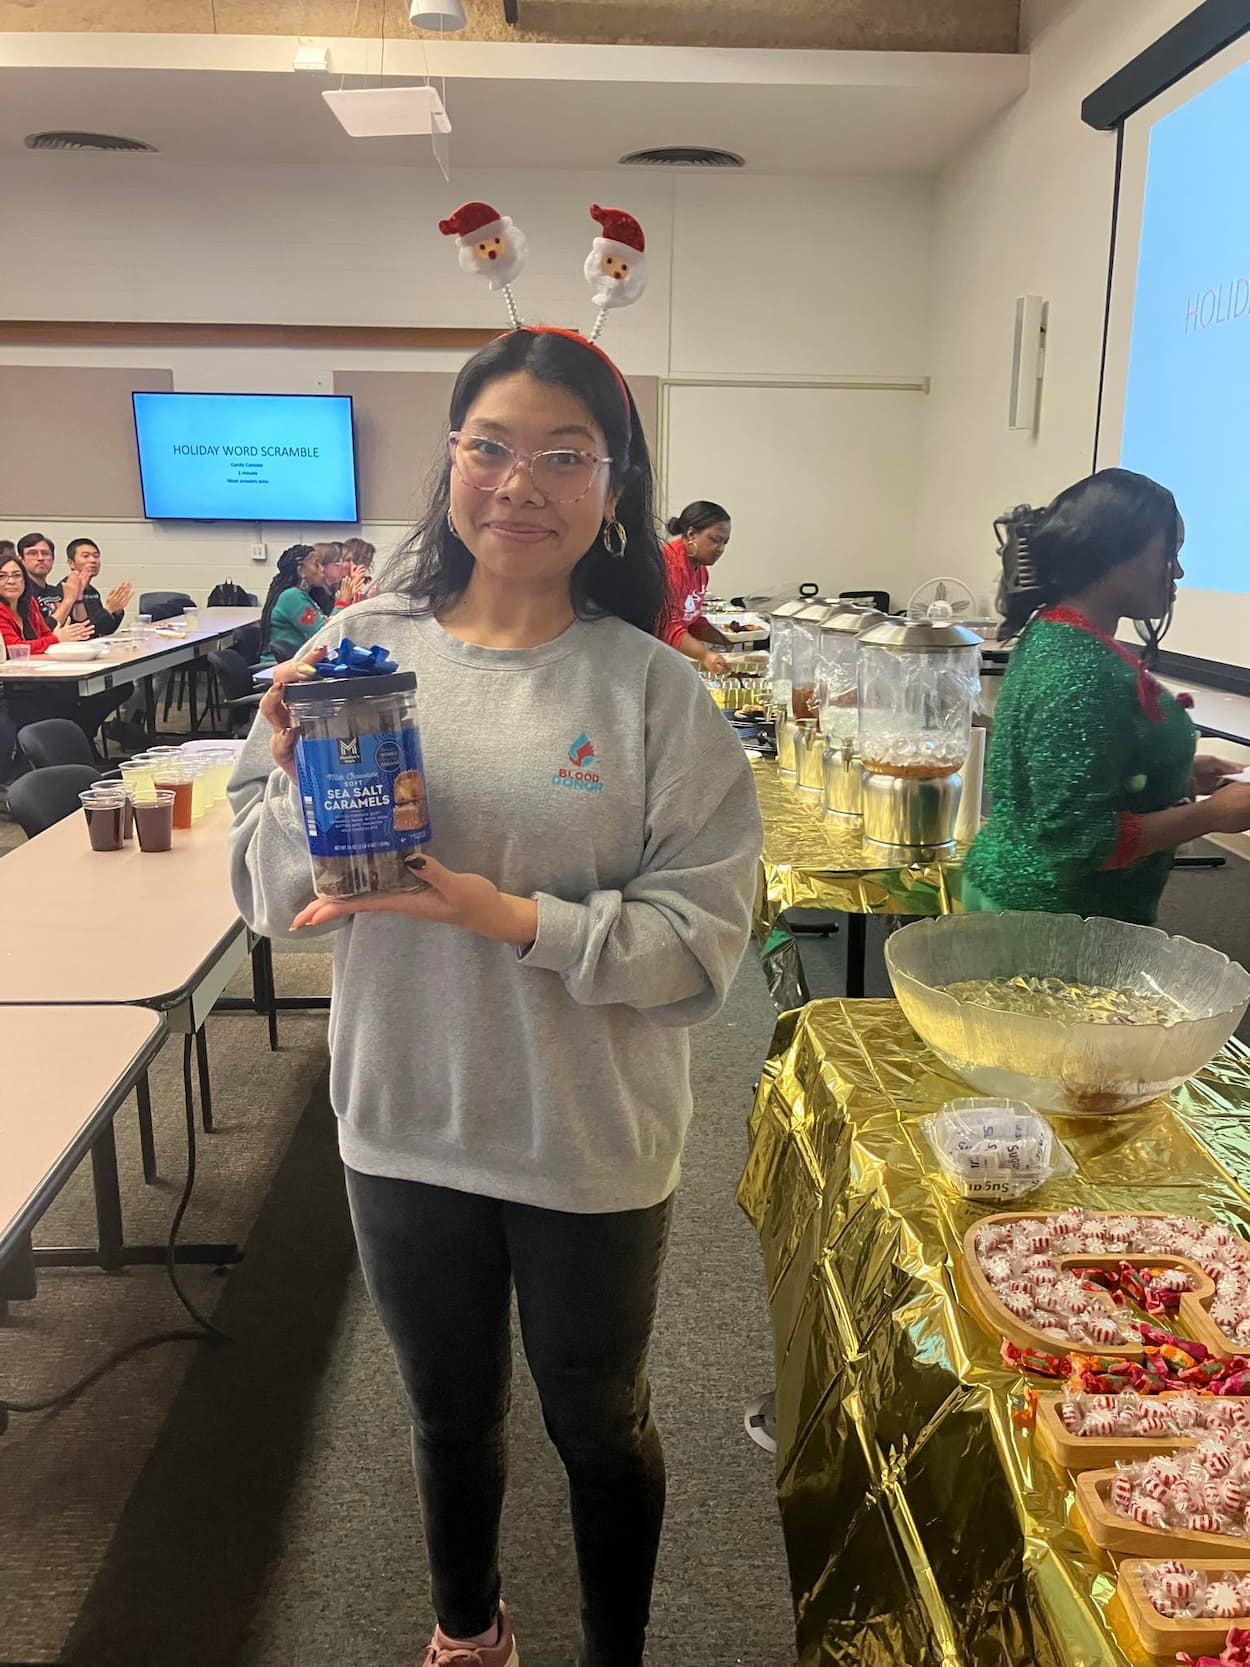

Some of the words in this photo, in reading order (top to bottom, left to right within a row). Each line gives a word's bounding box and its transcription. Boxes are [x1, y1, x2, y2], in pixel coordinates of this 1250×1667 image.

[1184, 278, 1250, 336] HOLID
[172, 444, 219, 456] HOLIDAY
[222, 445, 258, 457] WORD
[261, 446, 320, 458] SCRAMBLE
[559, 768, 600, 783] BLOOD
[327, 788, 351, 800] SEA
[353, 784, 384, 797] SALT
[323, 794, 391, 811] CARAMELS
[1007, 1144, 1020, 1169] Suga
